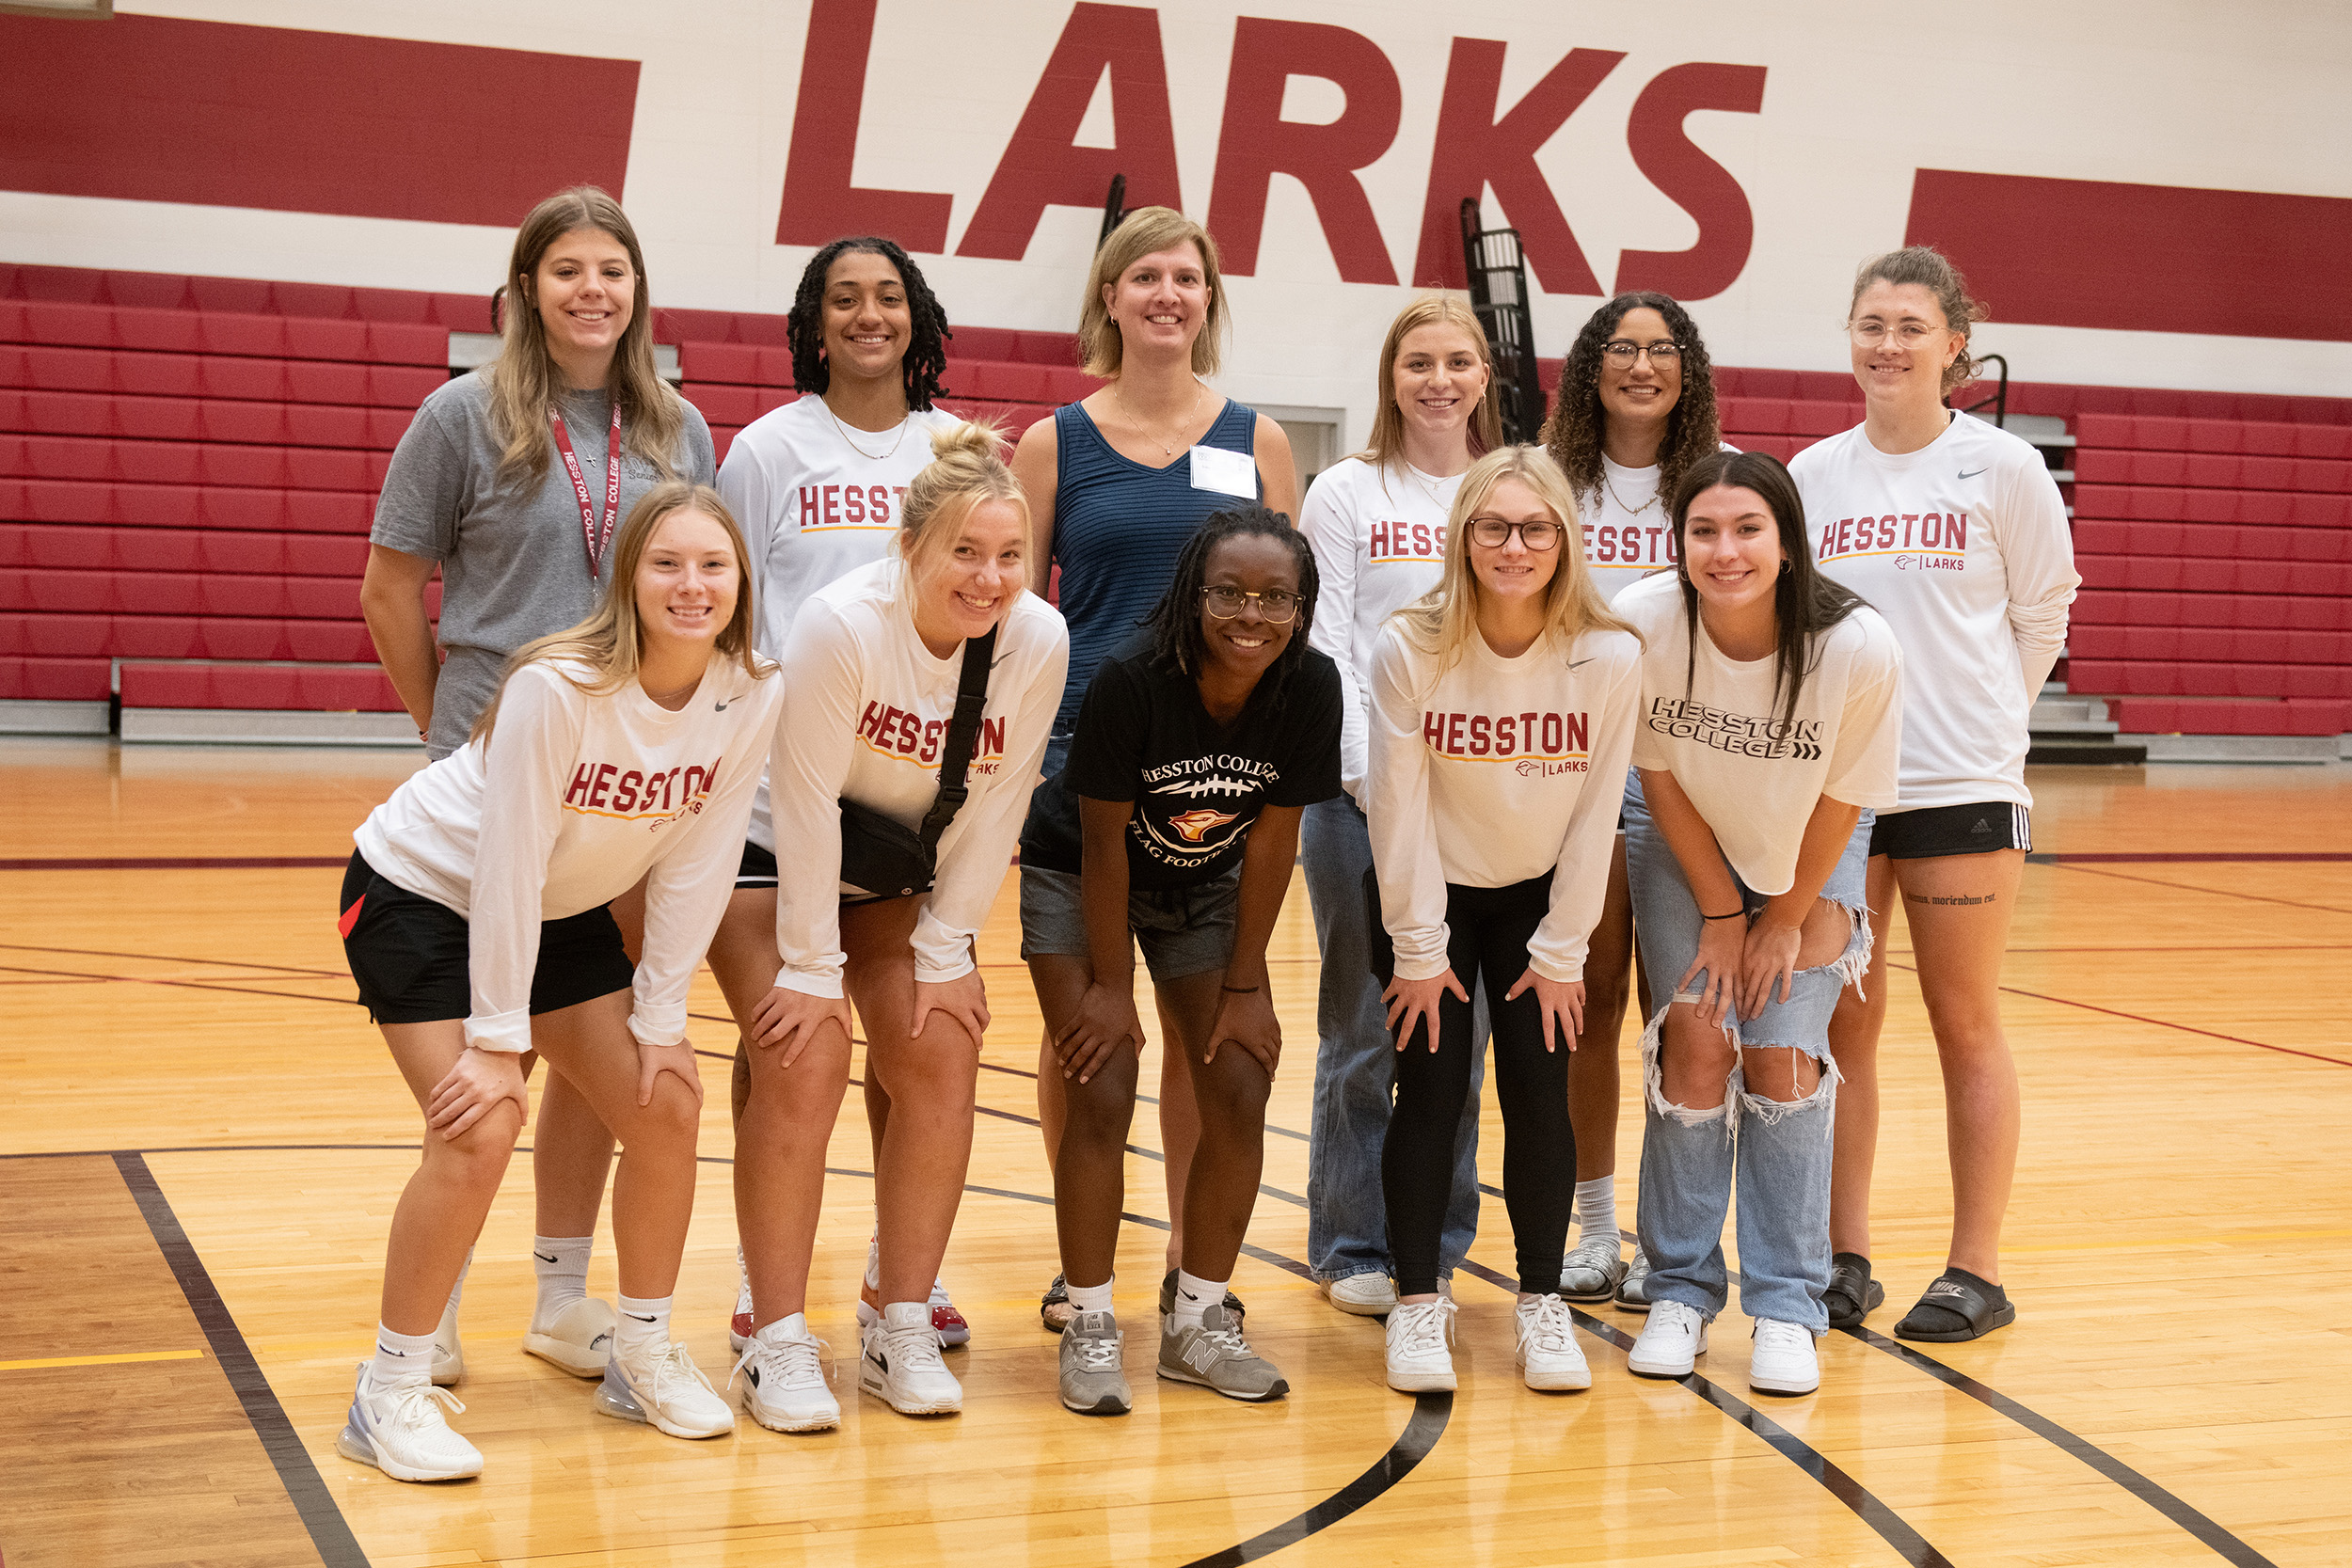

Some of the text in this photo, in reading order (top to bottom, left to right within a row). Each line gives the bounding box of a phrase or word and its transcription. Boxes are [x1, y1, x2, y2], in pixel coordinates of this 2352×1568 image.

[775, 0, 1768, 303] LARKS
[564, 451, 590, 503] HESSTON
[608, 456, 620, 503] COLLEGE
[799, 484, 910, 527] HESST
[1370, 520, 1447, 558] HESS
[1581, 524, 1678, 563] ESSTO
[1819, 513, 1967, 559] HESSTON
[1925, 557, 1964, 571] LARKS
[1423, 711, 1589, 756] HESSTON
[1648, 717, 1791, 759] COLLEGE
[1651, 696, 1825, 742] HESSTON
[1141, 754, 1214, 783] HESSTON
[1548, 761, 1589, 776] LARKS
[1129, 819, 1163, 858] FLAG
[1931, 1280, 1965, 1294] NIKE
